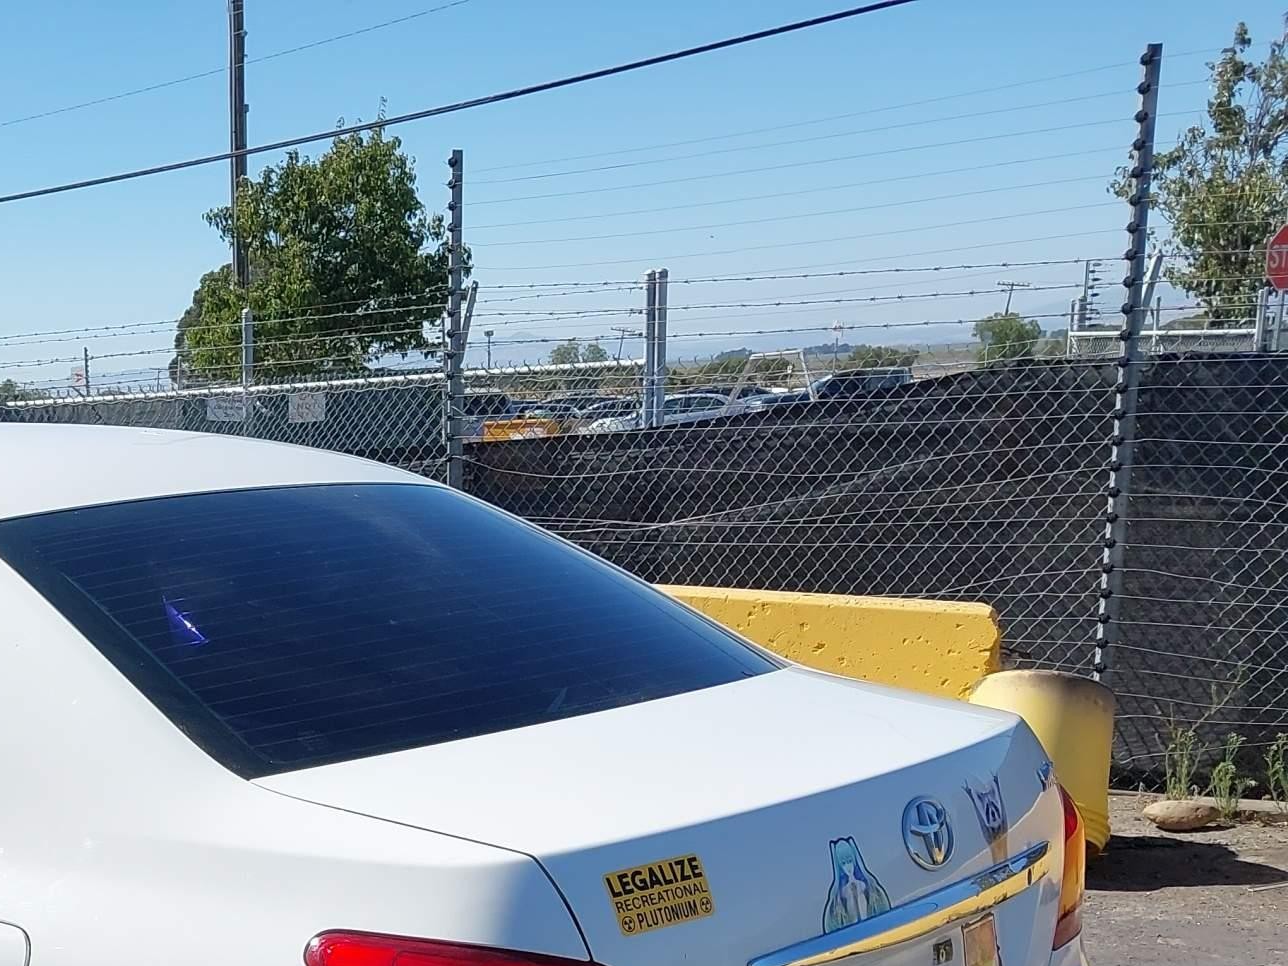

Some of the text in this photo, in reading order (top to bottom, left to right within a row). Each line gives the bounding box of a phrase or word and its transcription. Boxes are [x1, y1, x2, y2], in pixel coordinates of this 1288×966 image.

[605, 856, 703, 898] LEGALIZE
[614, 881, 708, 914] RECREATIONAL
[636, 899, 699, 930] PLUTONIUM
